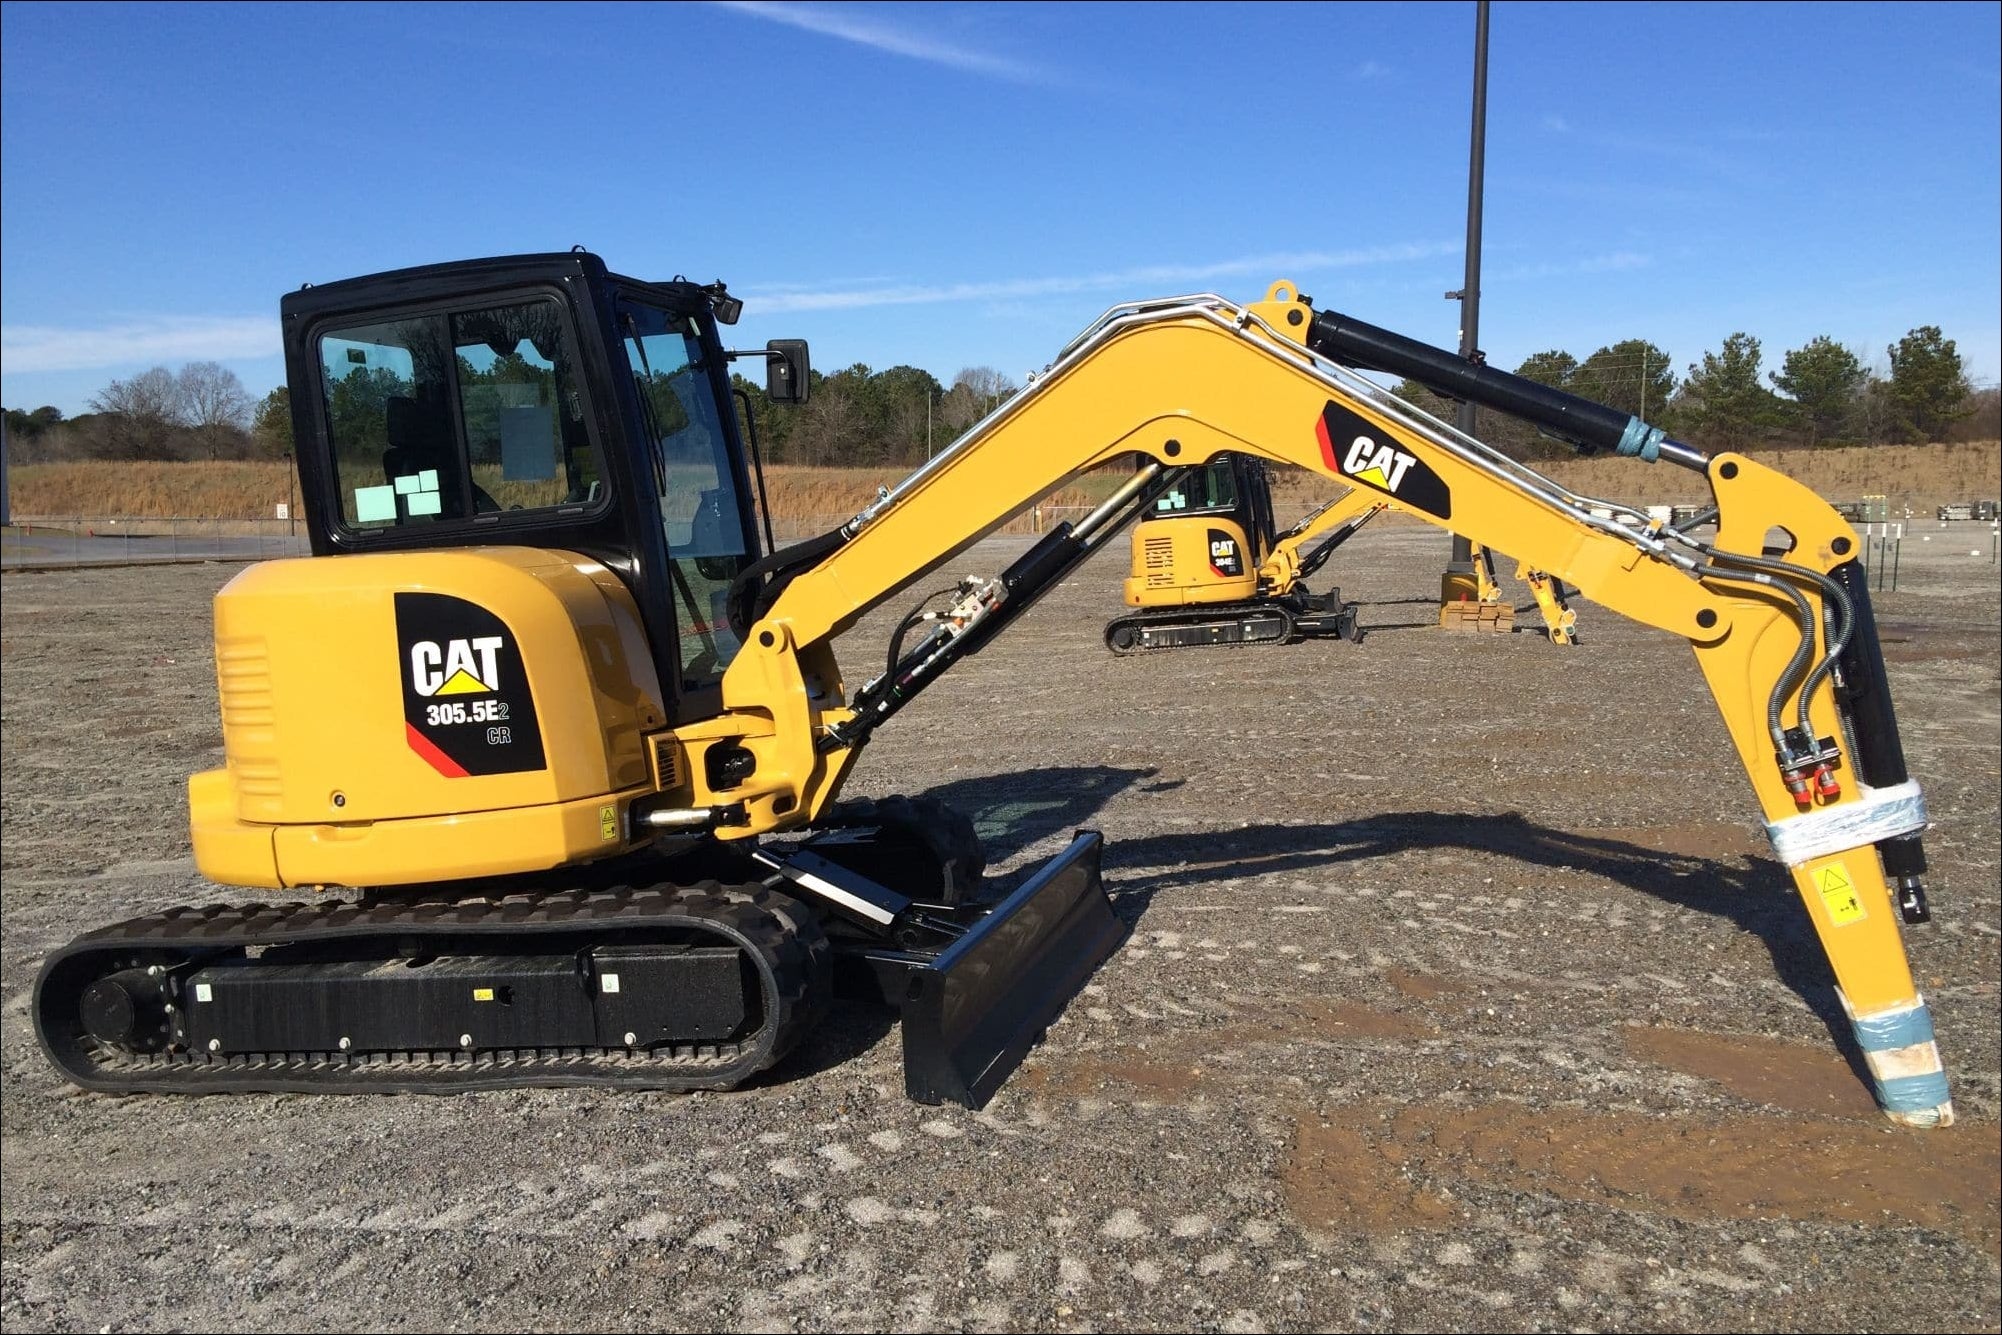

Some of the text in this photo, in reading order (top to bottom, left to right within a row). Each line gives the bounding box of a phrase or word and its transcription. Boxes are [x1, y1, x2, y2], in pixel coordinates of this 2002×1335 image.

[1343, 435, 1417, 493] CAT
[1211, 540, 1235, 557] CAT
[411, 636, 503, 697] CAT
[426, 699, 510, 726] 305.5E2
[486, 726, 512, 744] CR
